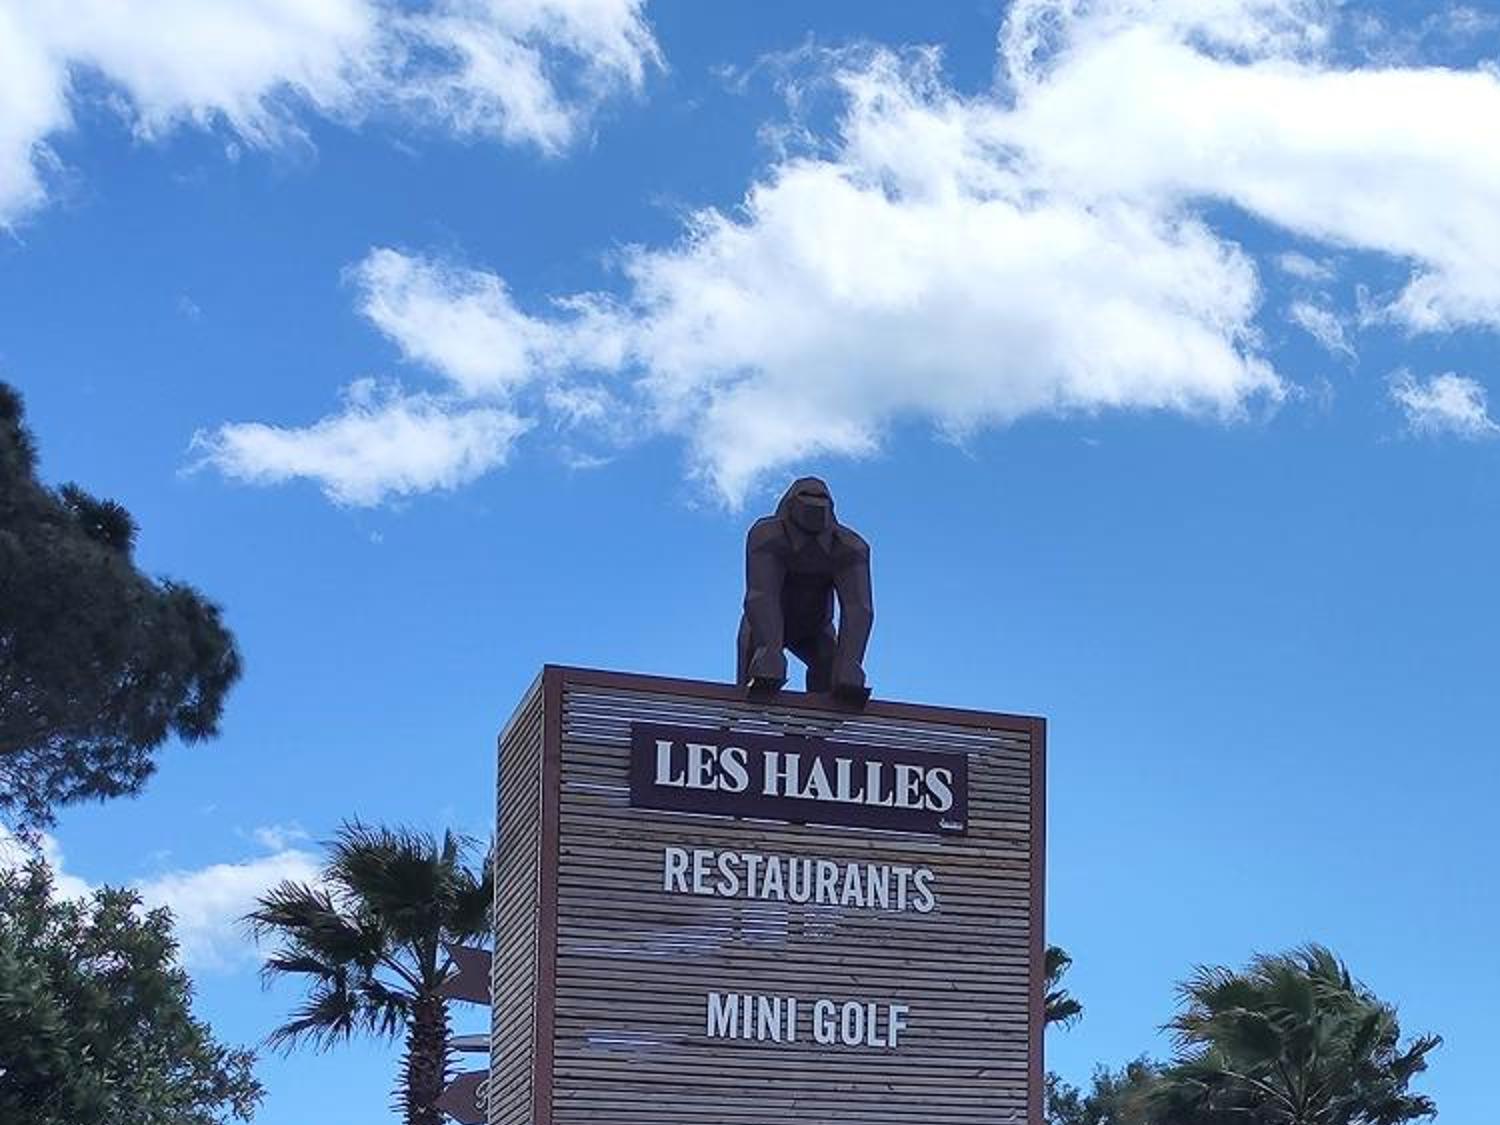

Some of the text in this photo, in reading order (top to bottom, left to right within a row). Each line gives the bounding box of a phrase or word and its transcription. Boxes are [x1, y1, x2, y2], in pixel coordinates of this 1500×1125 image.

[654, 739, 954, 812] LES HALLES
[663, 847, 936, 913] RESTAURANTS
[707, 992, 909, 1048] MINI GOLF
